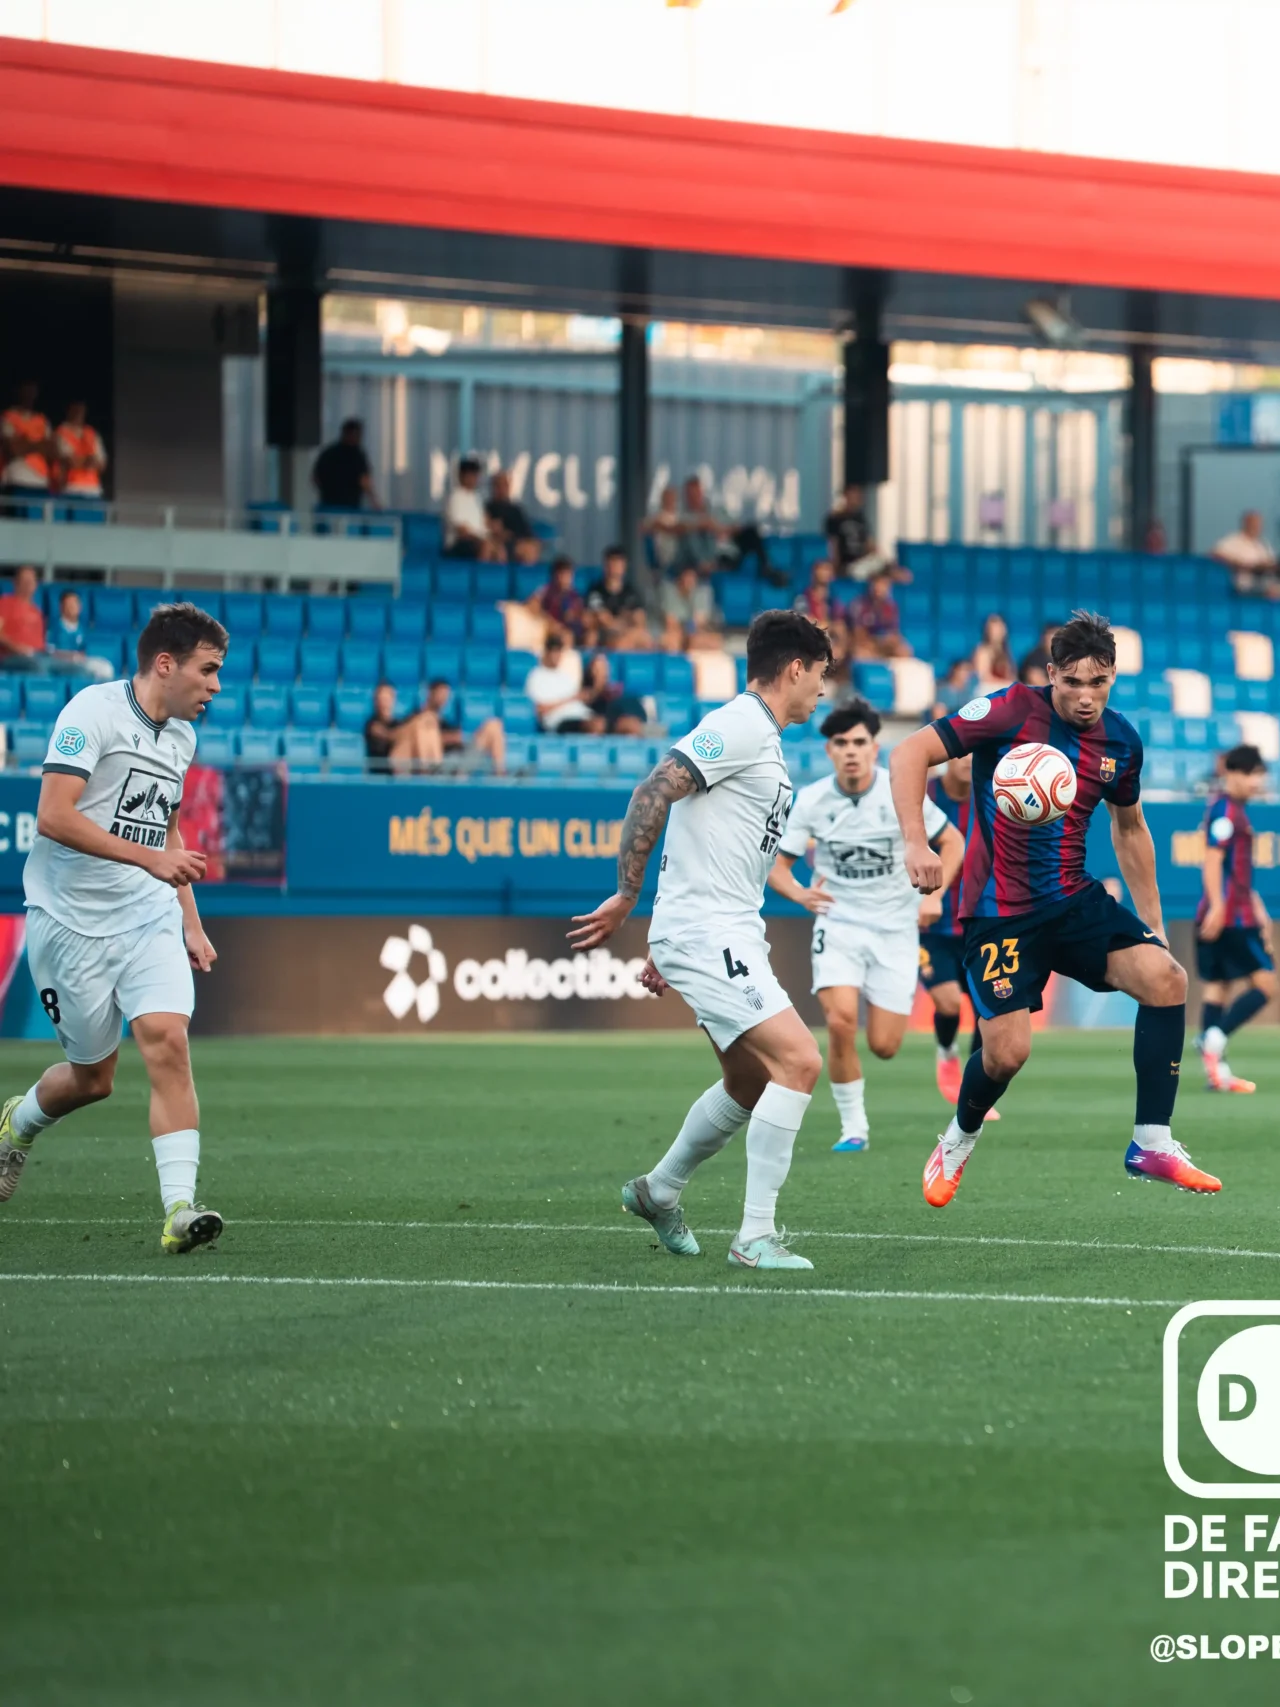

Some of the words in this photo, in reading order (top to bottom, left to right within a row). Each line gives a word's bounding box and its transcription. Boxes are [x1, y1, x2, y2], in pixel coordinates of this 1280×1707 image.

[389, 806, 452, 856] MÉS
[455, 816, 514, 864] QUE
[518, 817, 560, 857] UN
[454, 949, 658, 1001] collectibo
[723, 947, 750, 980] 4
[980, 938, 1019, 982] 23
[40, 987, 61, 1025] 8
